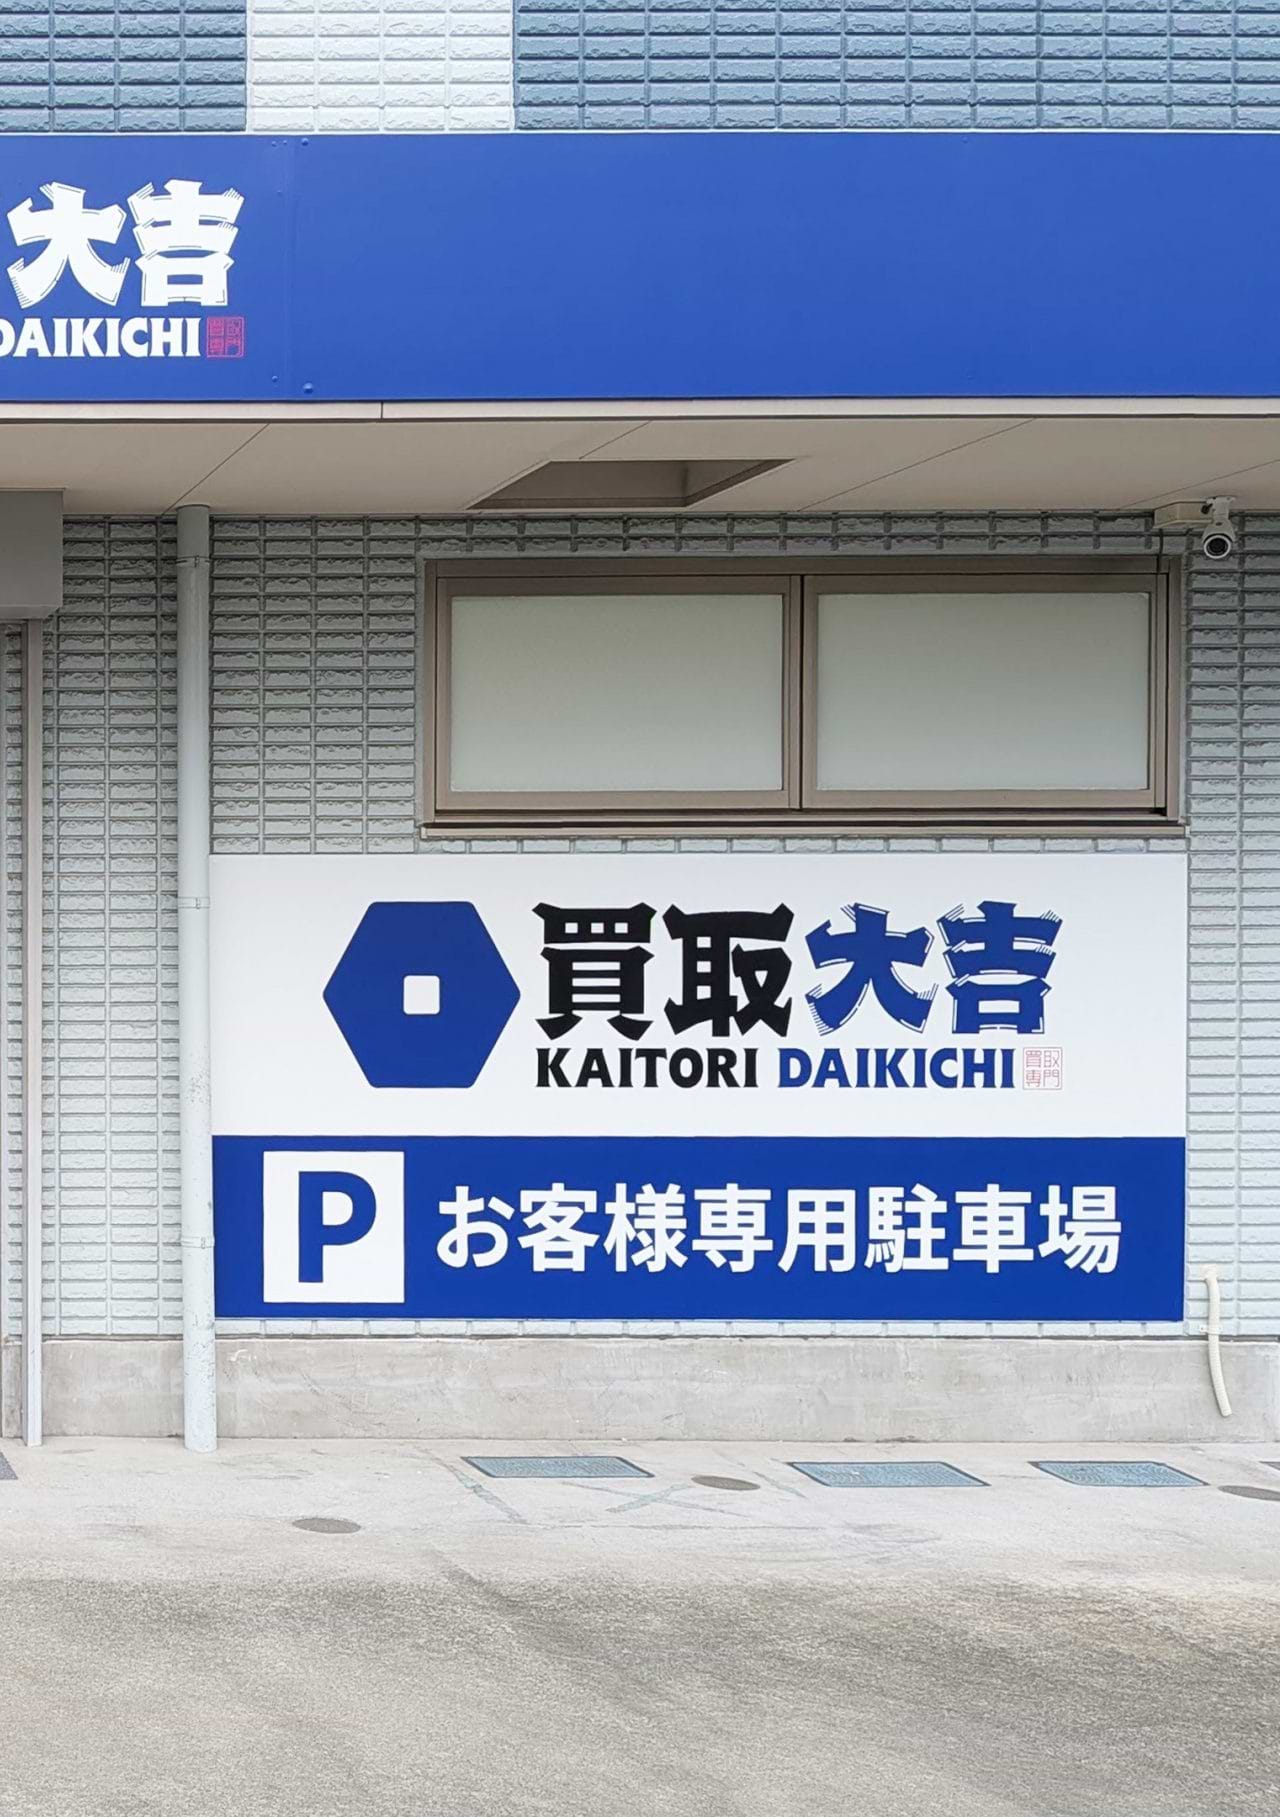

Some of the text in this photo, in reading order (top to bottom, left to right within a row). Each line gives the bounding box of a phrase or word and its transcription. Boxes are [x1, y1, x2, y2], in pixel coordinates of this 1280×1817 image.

[533, 900, 1064, 1039] 買取大吉
[535, 1047, 1016, 1089] KAITORI DAIKICHI
[298, 1171, 376, 1283] P
[436, 1182, 1122, 1274] お客様専用駐車場
